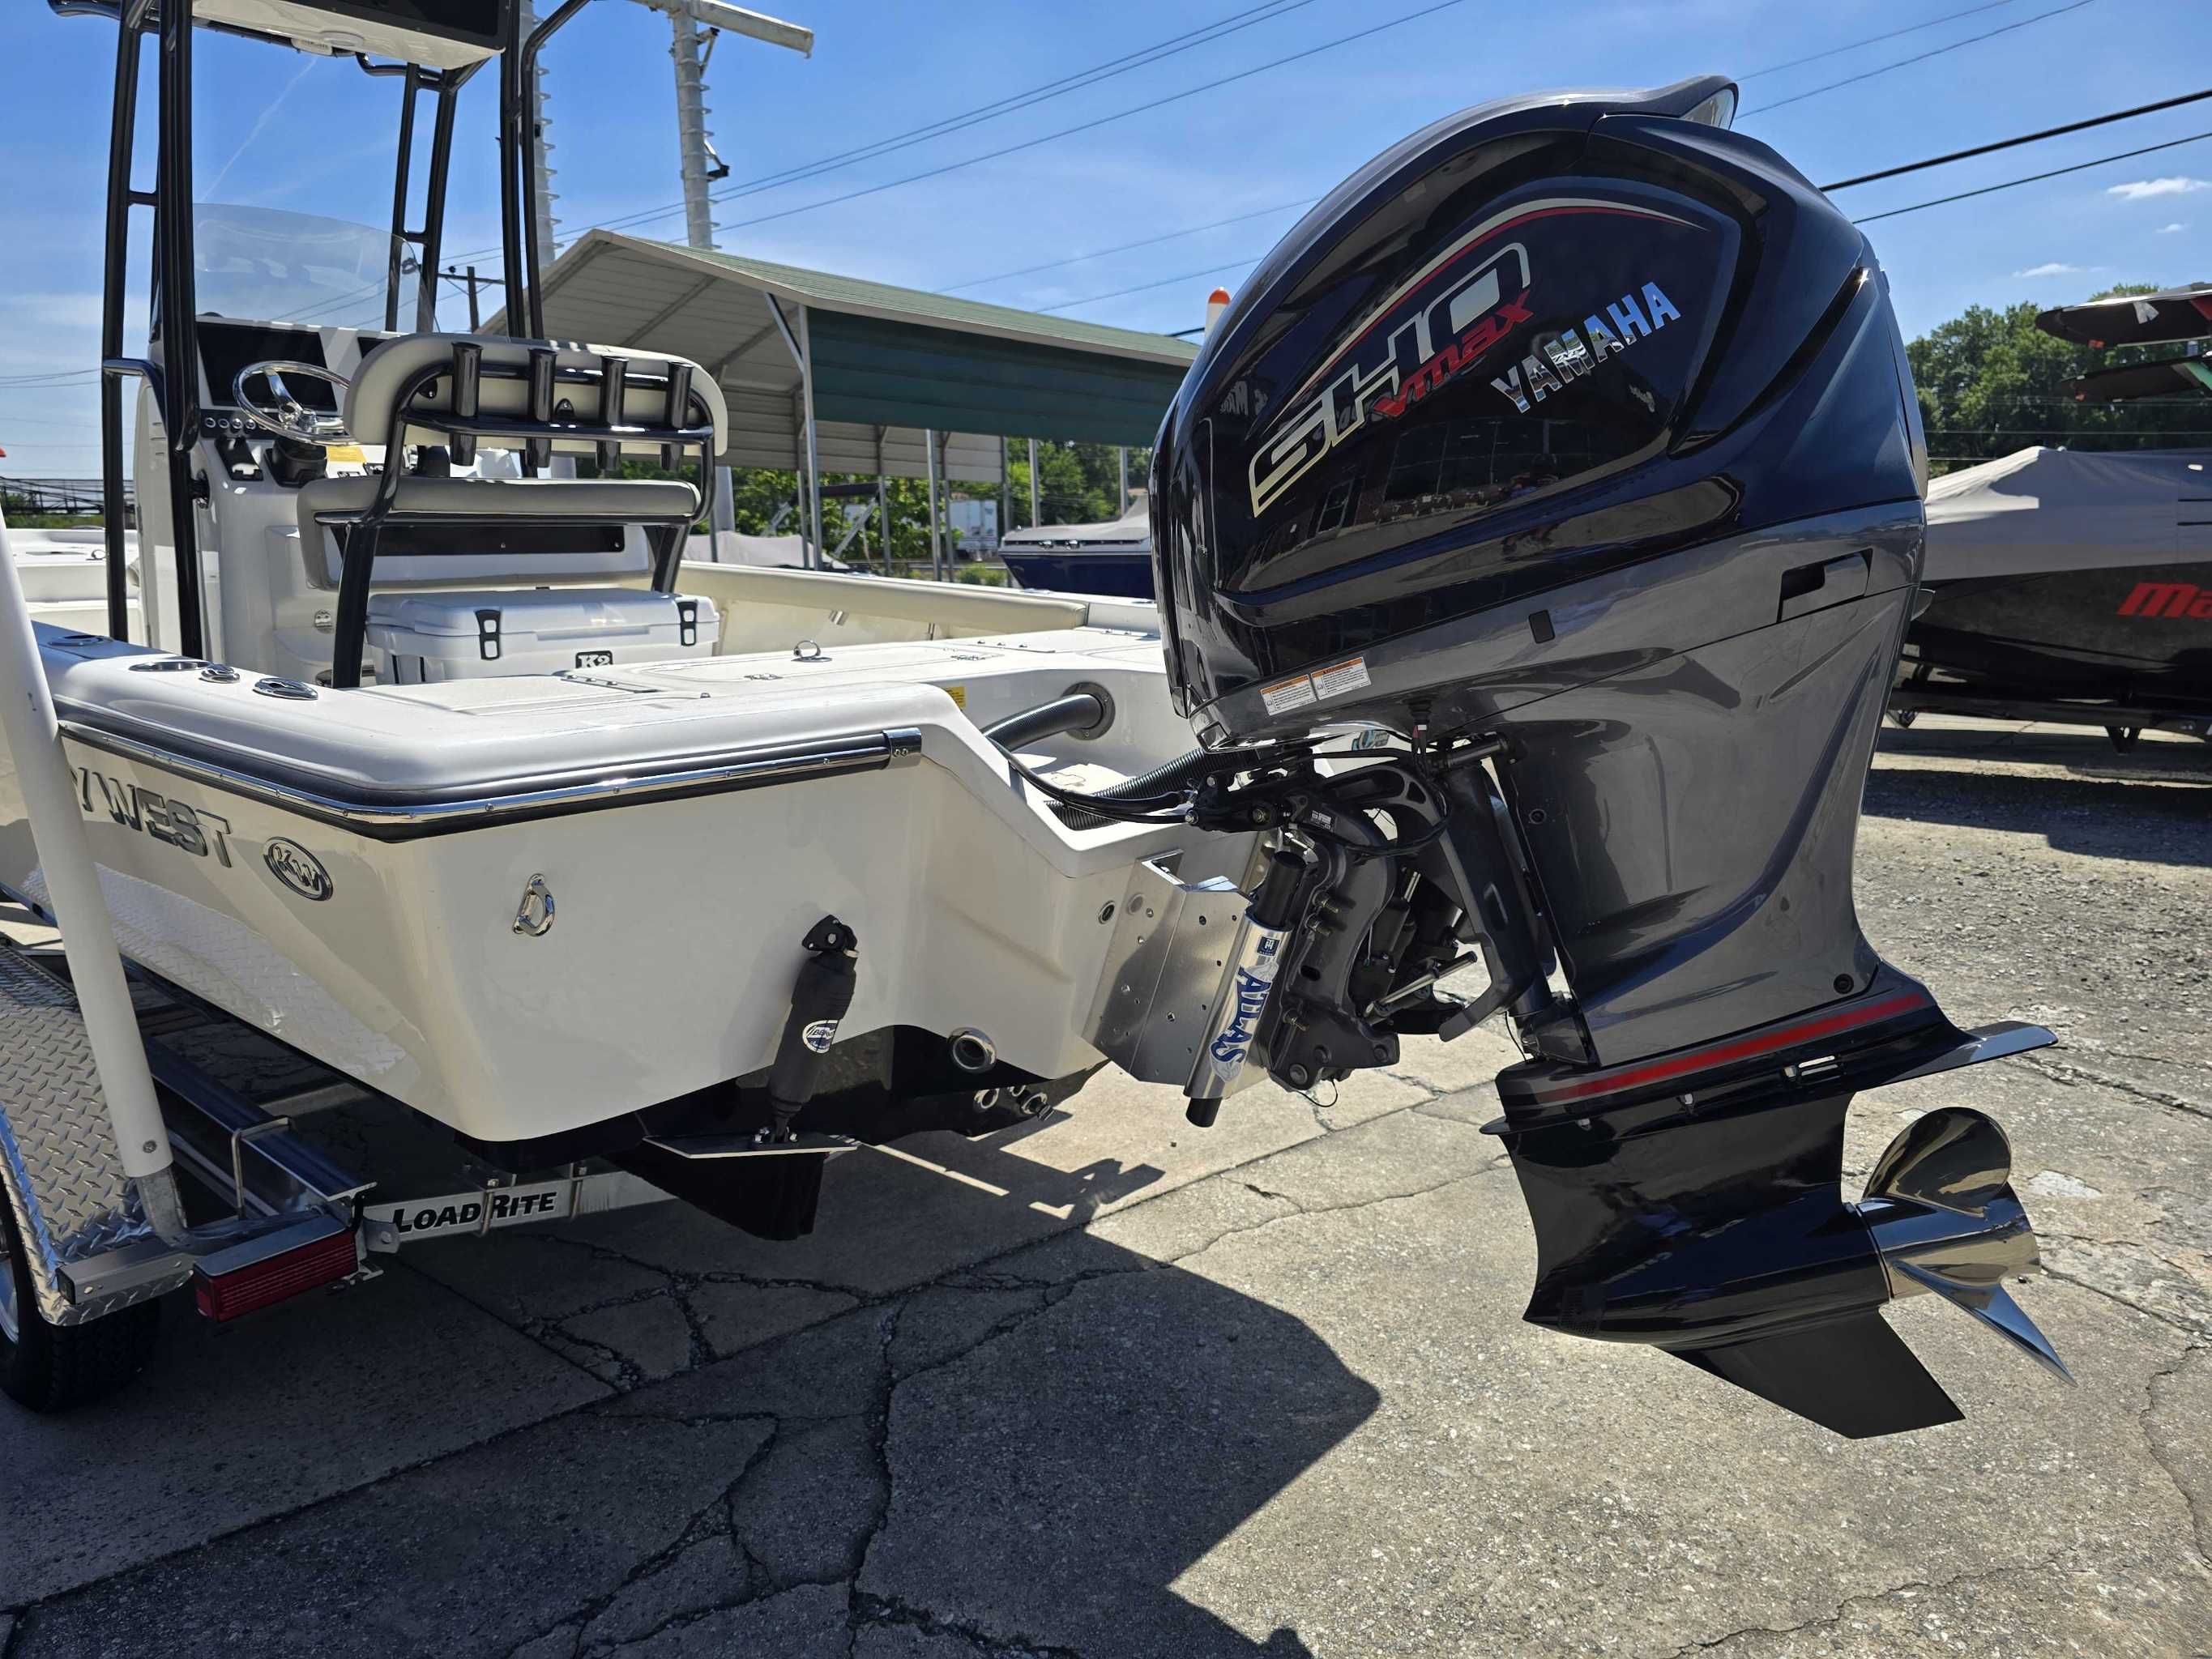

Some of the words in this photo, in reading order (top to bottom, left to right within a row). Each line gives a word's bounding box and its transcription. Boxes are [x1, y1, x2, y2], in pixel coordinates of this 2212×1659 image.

[1490, 281, 1681, 414] YAMAHA
[578, 653, 610, 668] K2
[92, 771, 233, 868] WEST
[274, 845, 321, 891] KW
[1210, 964, 1273, 1064] ATLAS
